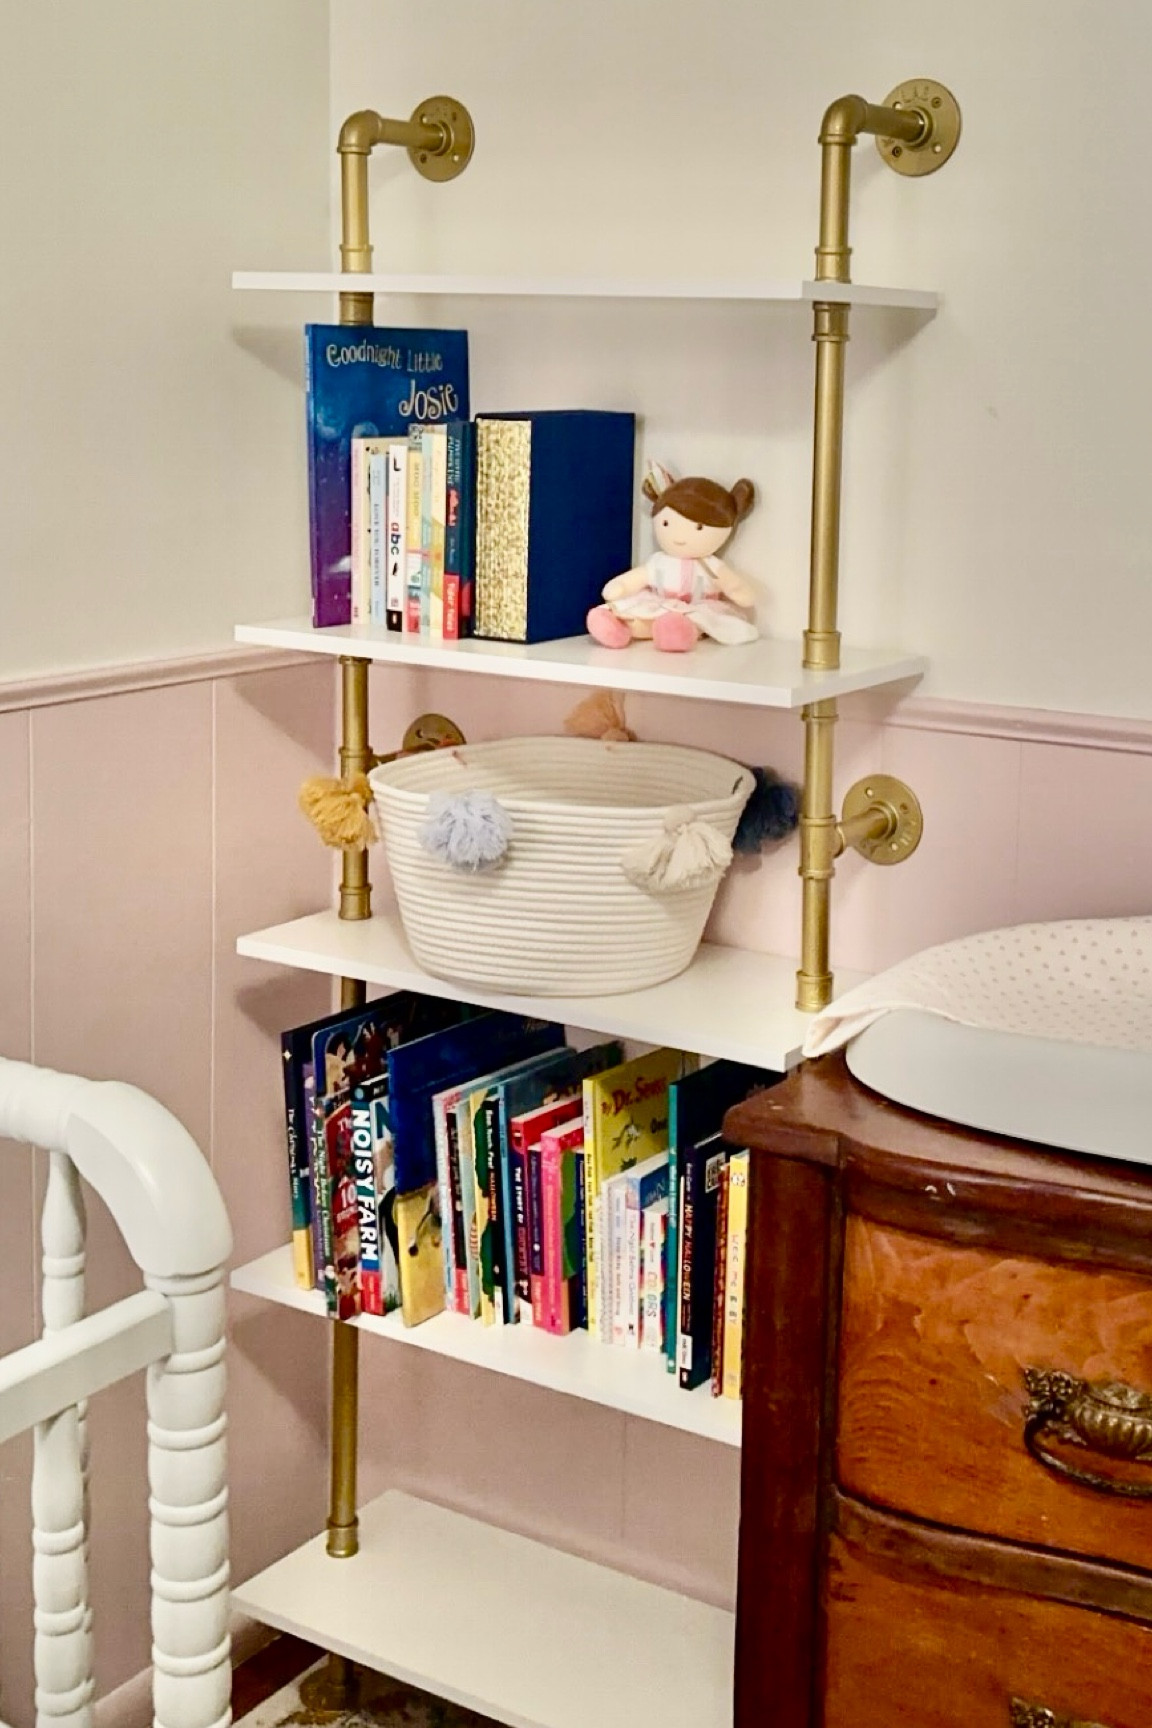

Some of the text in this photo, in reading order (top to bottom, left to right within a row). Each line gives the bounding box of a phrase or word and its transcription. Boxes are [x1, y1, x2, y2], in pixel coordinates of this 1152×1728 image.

[326, 338, 443, 372] Goodnight Little
[398, 378, 458, 419] Josie
[390, 522, 402, 555] abc
[612, 1089, 641, 1116] Dr.
[316, 1130, 325, 1147] The
[317, 1150, 327, 1175] Night
[514, 1166, 522, 1183] THE
[351, 1108, 378, 1261] NOISY FARM
[515, 1185, 524, 1212] STORY
[323, 1209, 332, 1257] Christmas
[684, 1203, 694, 1238] HAPPY
[683, 1239, 693, 1301] HALLOWEEN
